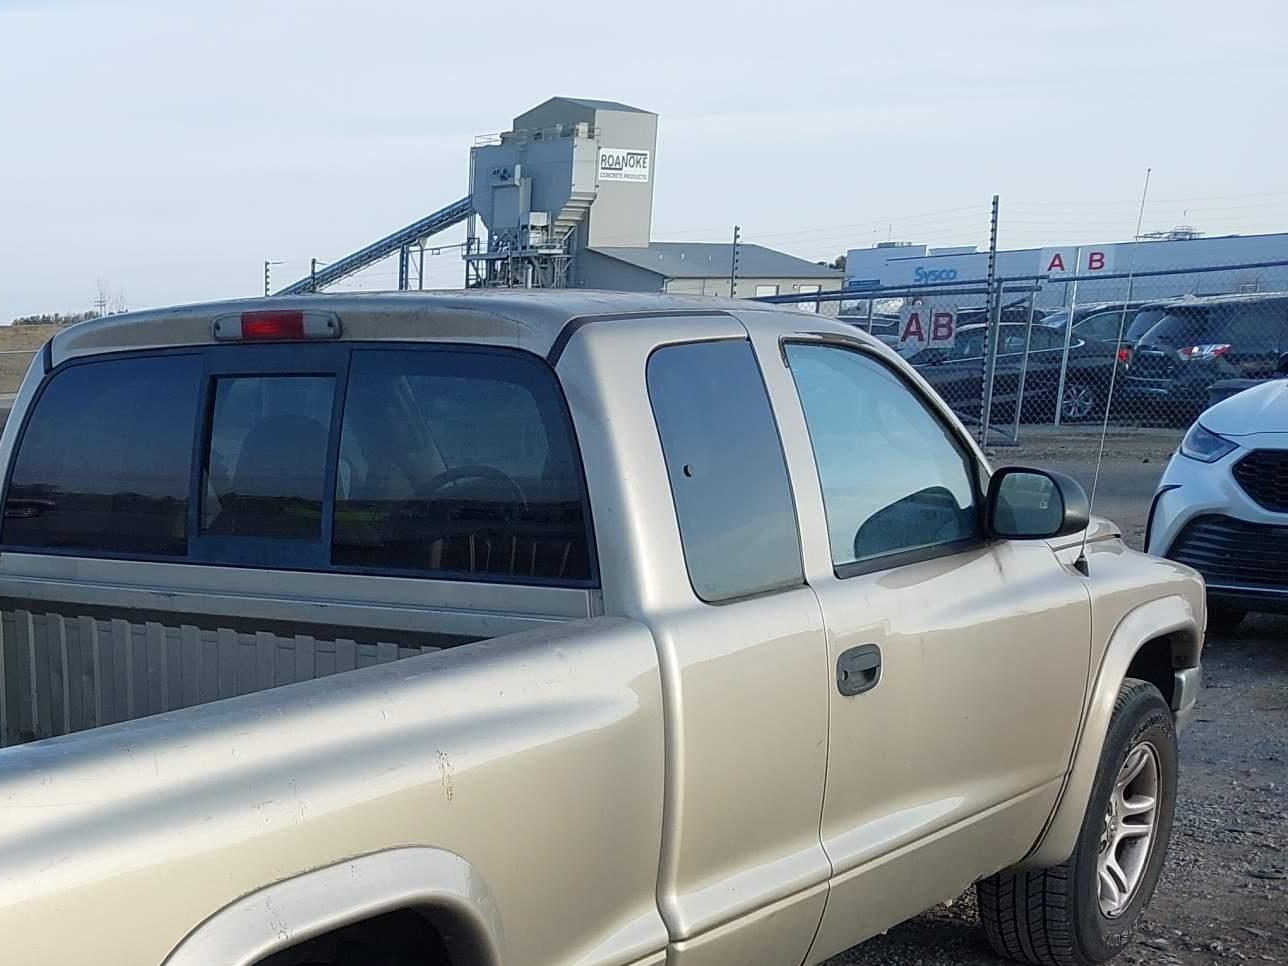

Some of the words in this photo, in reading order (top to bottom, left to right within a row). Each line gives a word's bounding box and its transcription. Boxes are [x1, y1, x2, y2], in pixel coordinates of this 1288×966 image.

[601, 153, 648, 169] ROANOKE
[1047, 253, 1065, 271] A
[1088, 252, 1105, 270] B
[914, 266, 957, 283] Sysco
[900, 312, 925, 342] A
[932, 312, 953, 341] B
